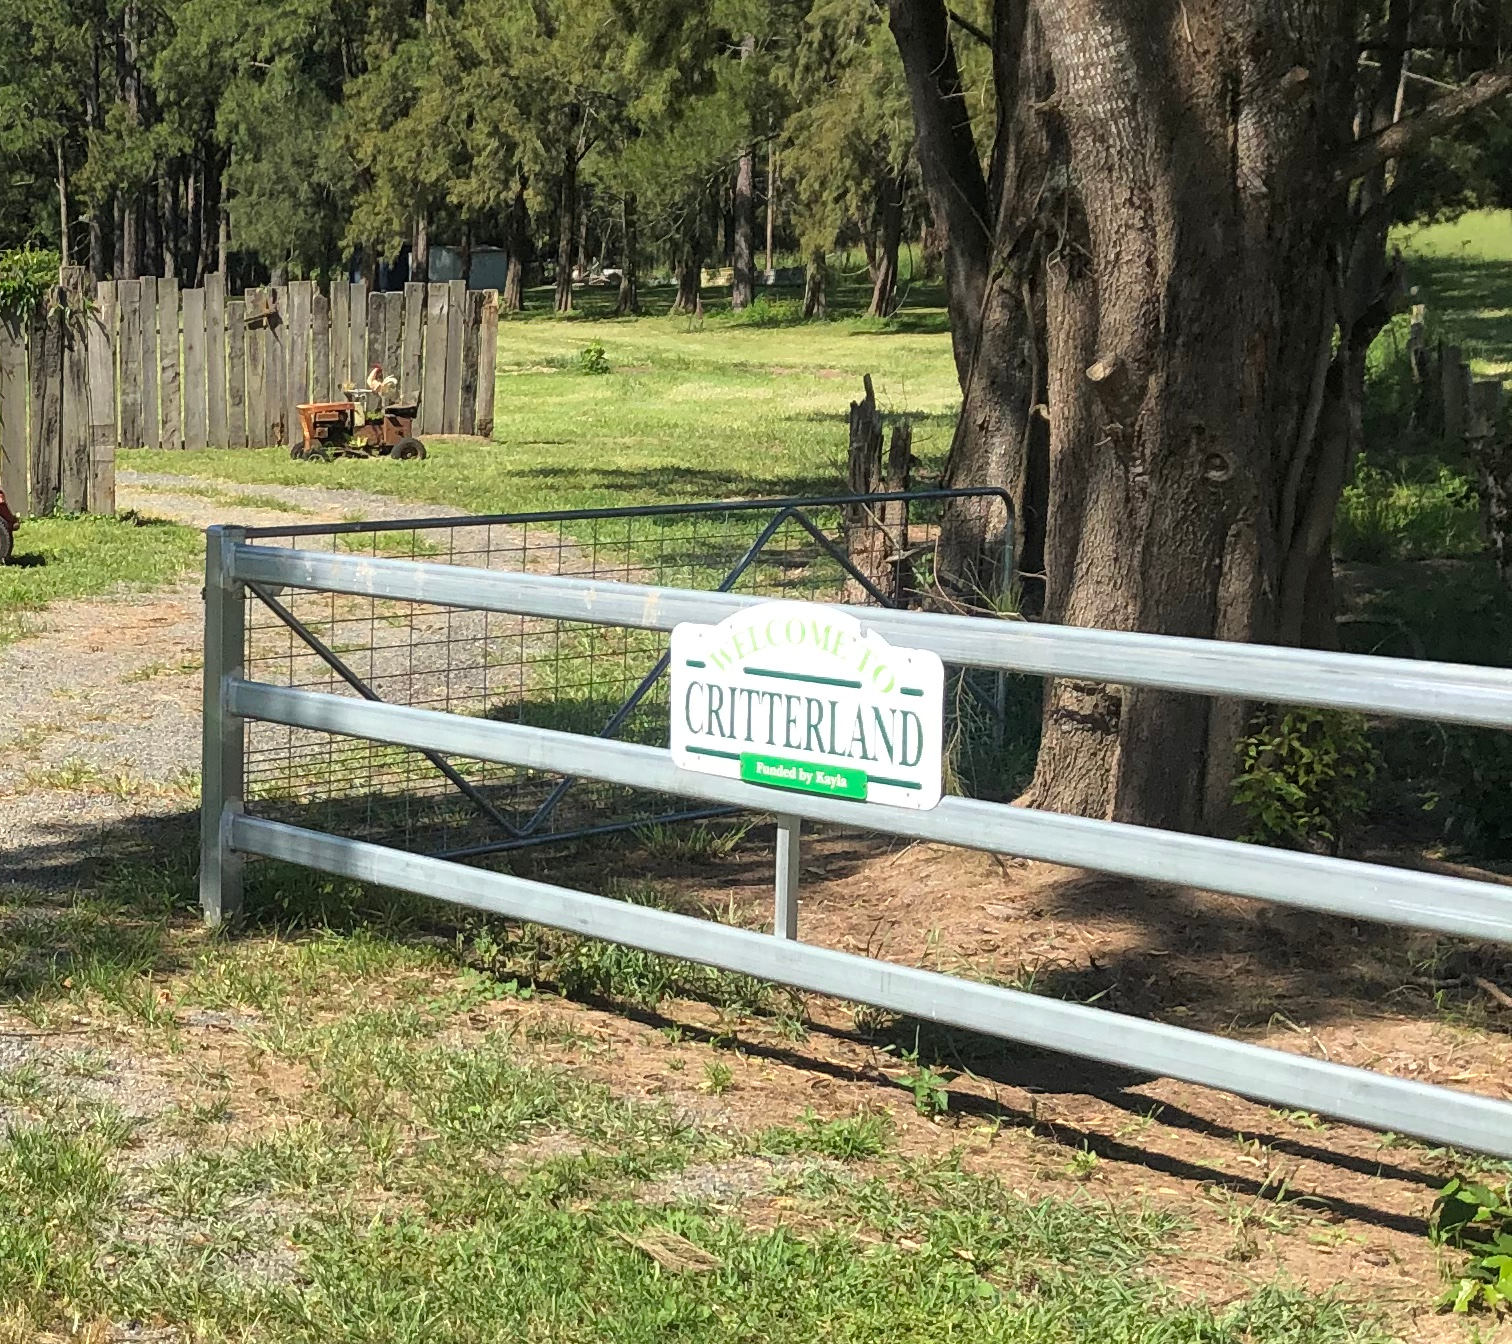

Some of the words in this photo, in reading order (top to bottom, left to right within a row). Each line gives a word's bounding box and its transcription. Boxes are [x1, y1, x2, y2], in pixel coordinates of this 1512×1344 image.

[708, 617, 846, 672] WELCOME
[855, 644, 896, 694] TO
[684, 680, 924, 768] CRITTERLAND
[755, 761, 797, 780] Funded
[799, 767, 813, 785] by
[815, 770, 848, 789] Kayla
